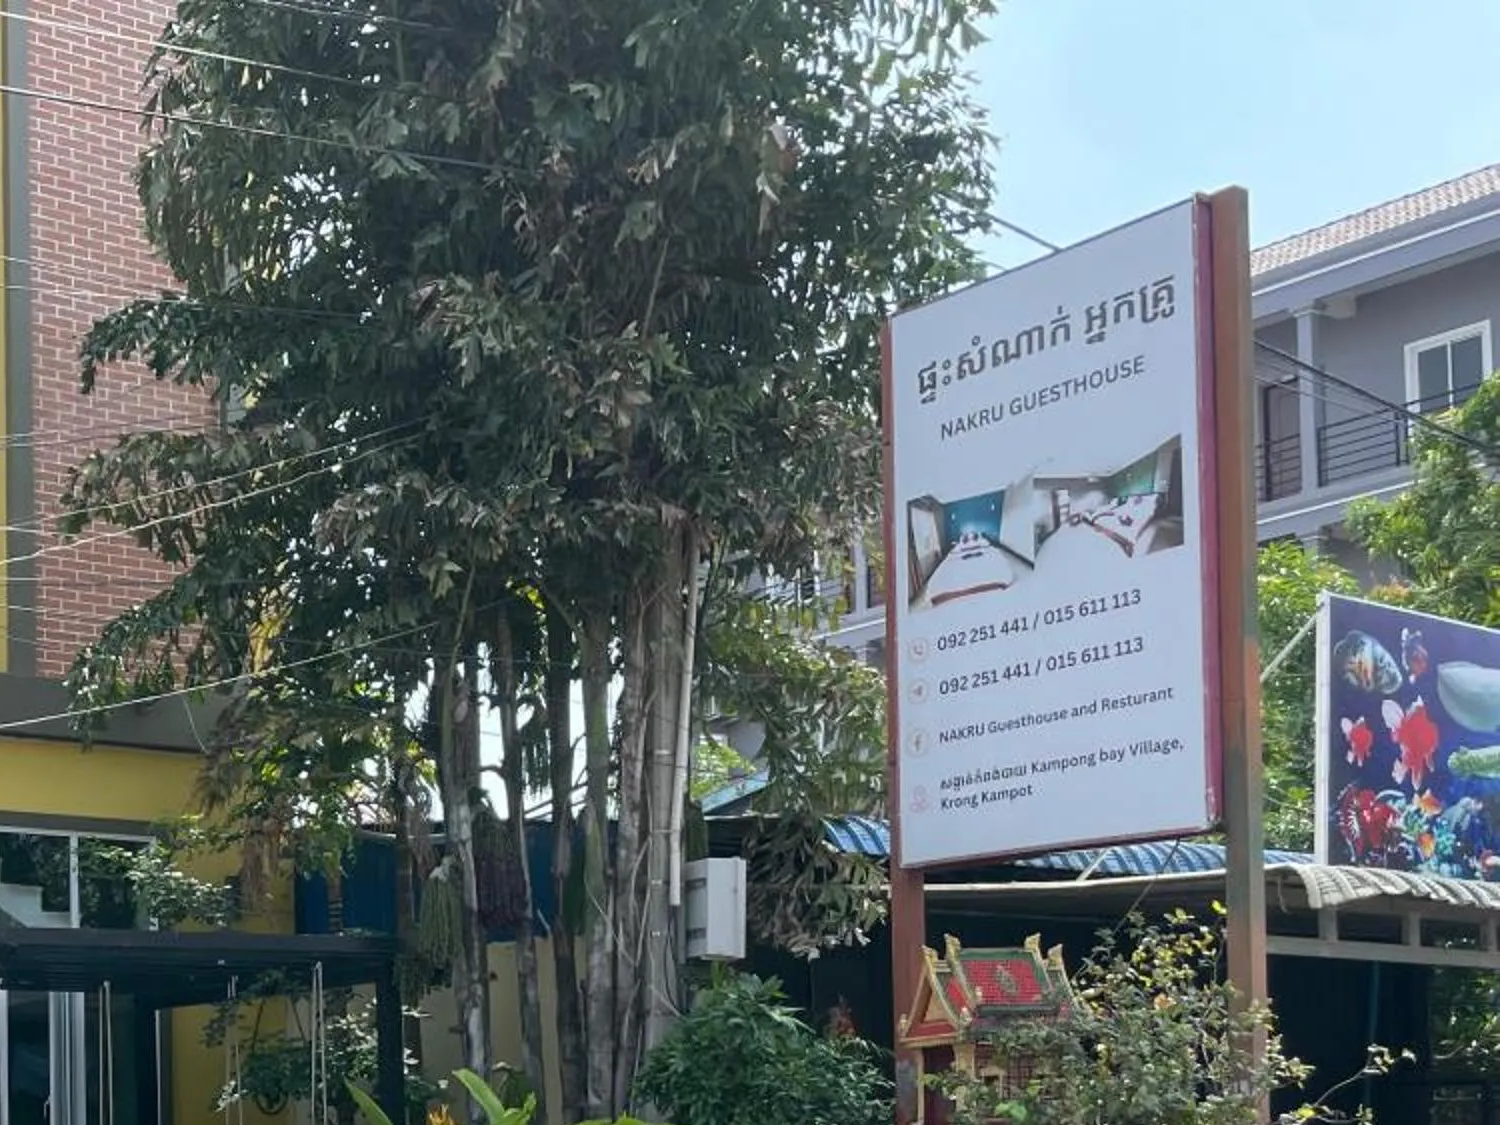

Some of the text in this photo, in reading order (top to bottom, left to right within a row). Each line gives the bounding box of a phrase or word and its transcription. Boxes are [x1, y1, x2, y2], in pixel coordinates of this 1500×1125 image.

[940, 355, 1145, 440] NAKRU GUESTHOUSE
[937, 589, 1141, 651] 092 251 441 / 015 611 113
[939, 637, 1143, 694] 092 251 441 / 015 611 113
[939, 688, 1174, 743] NAKRU Guesthouse and Resturant
[1031, 751, 1097, 774] Kampong
[1099, 747, 1125, 764] bay
[1129, 737, 1184, 756] Village,
[940, 784, 1033, 811] Krong Kampot
